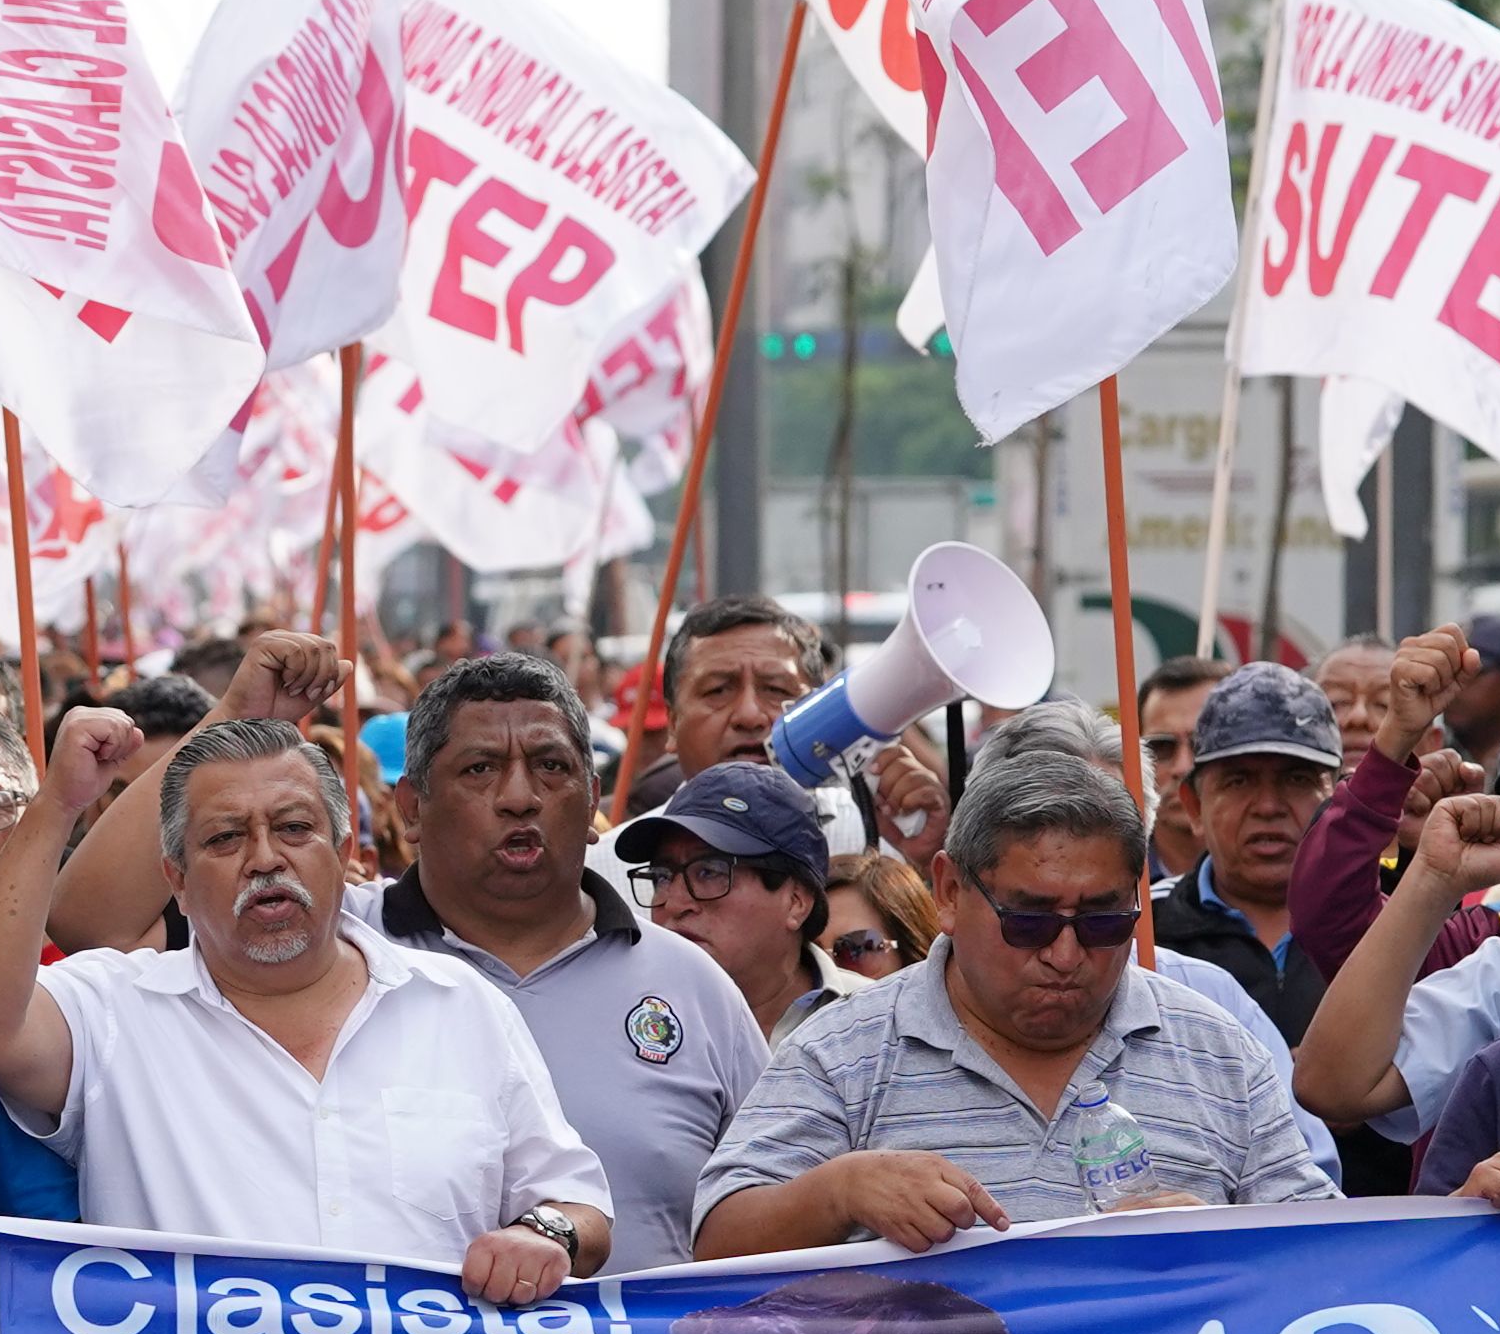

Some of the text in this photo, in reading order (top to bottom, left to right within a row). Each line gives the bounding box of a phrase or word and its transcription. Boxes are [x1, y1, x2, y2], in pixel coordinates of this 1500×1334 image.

[446, 36, 583, 163] SINDICAL
[551, 105, 698, 237] CLASISTA!
[1347, 21, 1464, 114] UNIDAD
